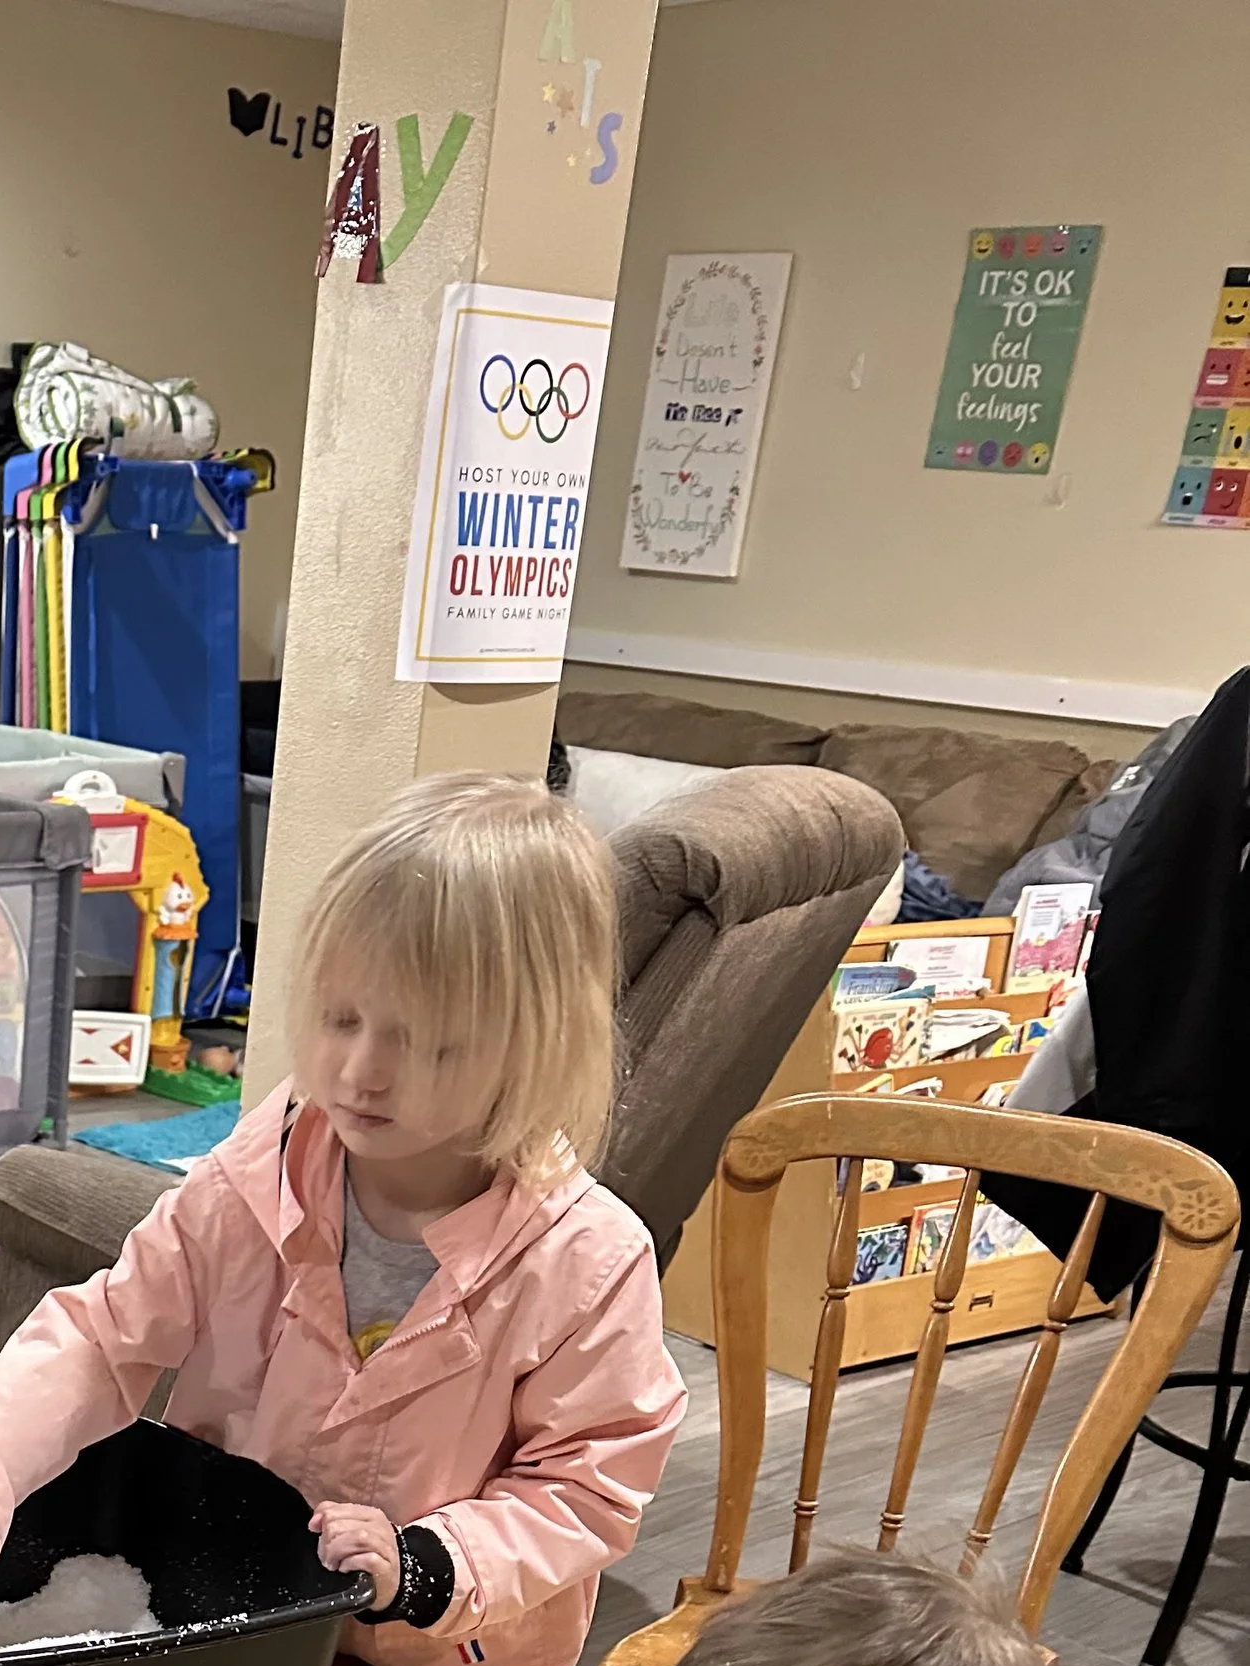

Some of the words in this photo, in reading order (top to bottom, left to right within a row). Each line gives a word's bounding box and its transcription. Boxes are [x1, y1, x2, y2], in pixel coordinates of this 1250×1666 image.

[979, 269, 1029, 296] IT'S
[1034, 269, 1075, 296] OK
[1002, 301, 1038, 327] TO
[991, 331, 1032, 361] feel
[972, 363, 1042, 389] YOUR
[957, 391, 1042, 432] feelings
[459, 467, 502, 483] HOST
[511, 470, 550, 486] YOUR
[557, 472, 586, 488] OWN
[457, 491, 580, 550] WINTER
[450, 554, 572, 598] OLYMPICS
[447, 606, 496, 619] FAMILY
[502, 607, 532, 620] GAME
[537, 607, 567, 620] NIGHT
